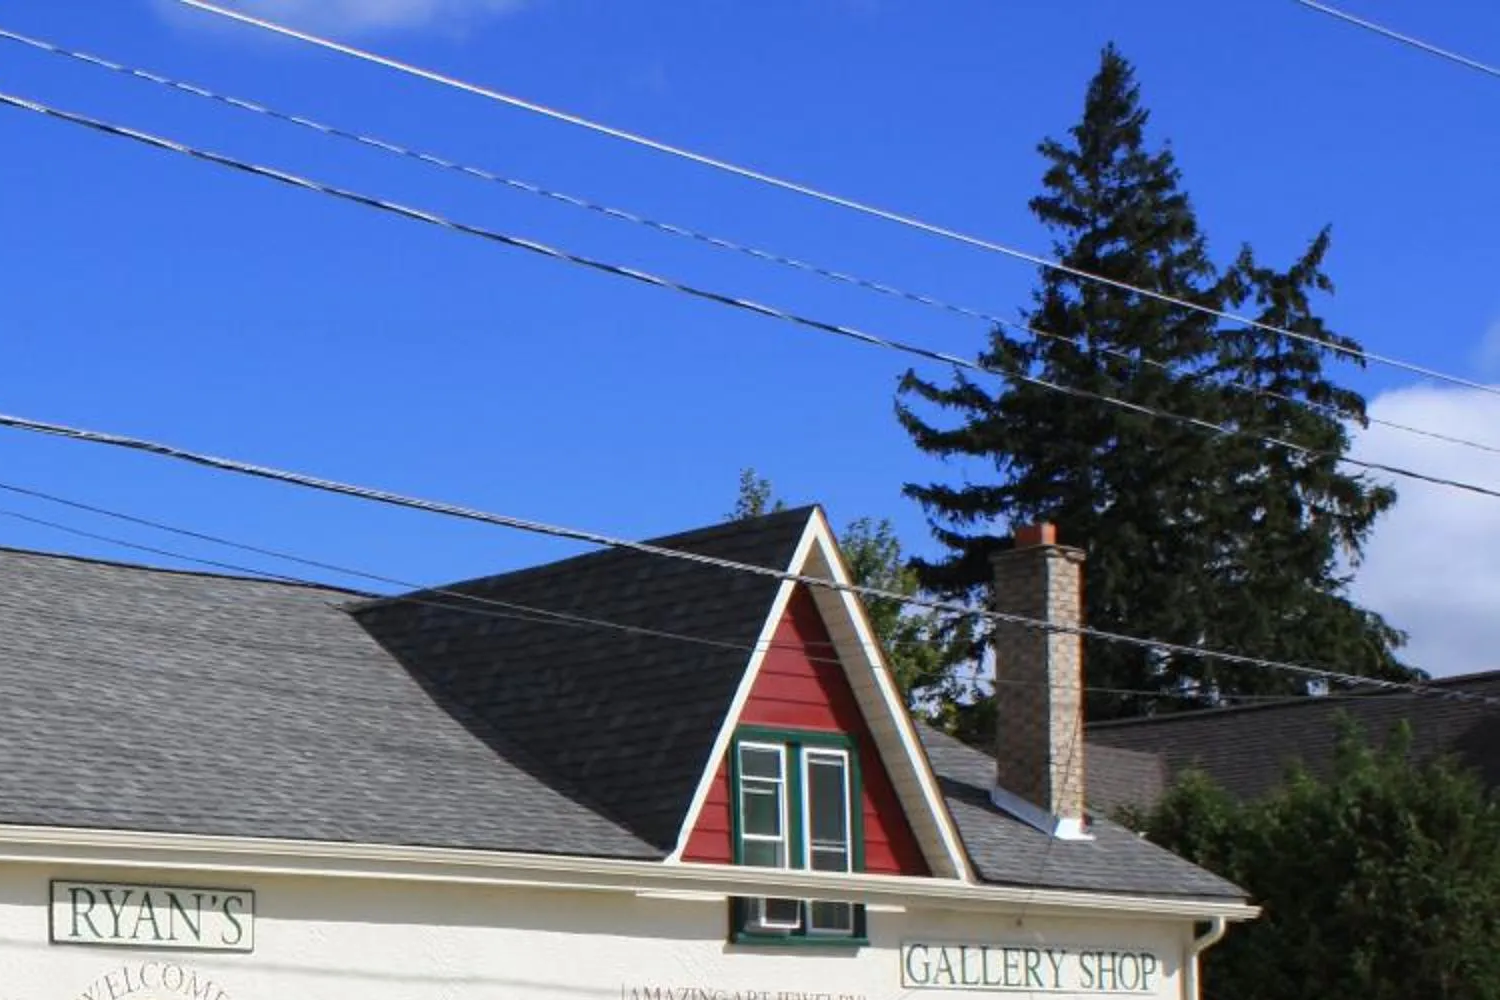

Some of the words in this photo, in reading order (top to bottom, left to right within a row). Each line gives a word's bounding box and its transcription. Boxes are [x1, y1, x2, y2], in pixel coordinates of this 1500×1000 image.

[68, 887, 244, 945] RYAN'S
[905, 943, 1066, 988] GALLERY
[1079, 950, 1157, 991] SHOP
